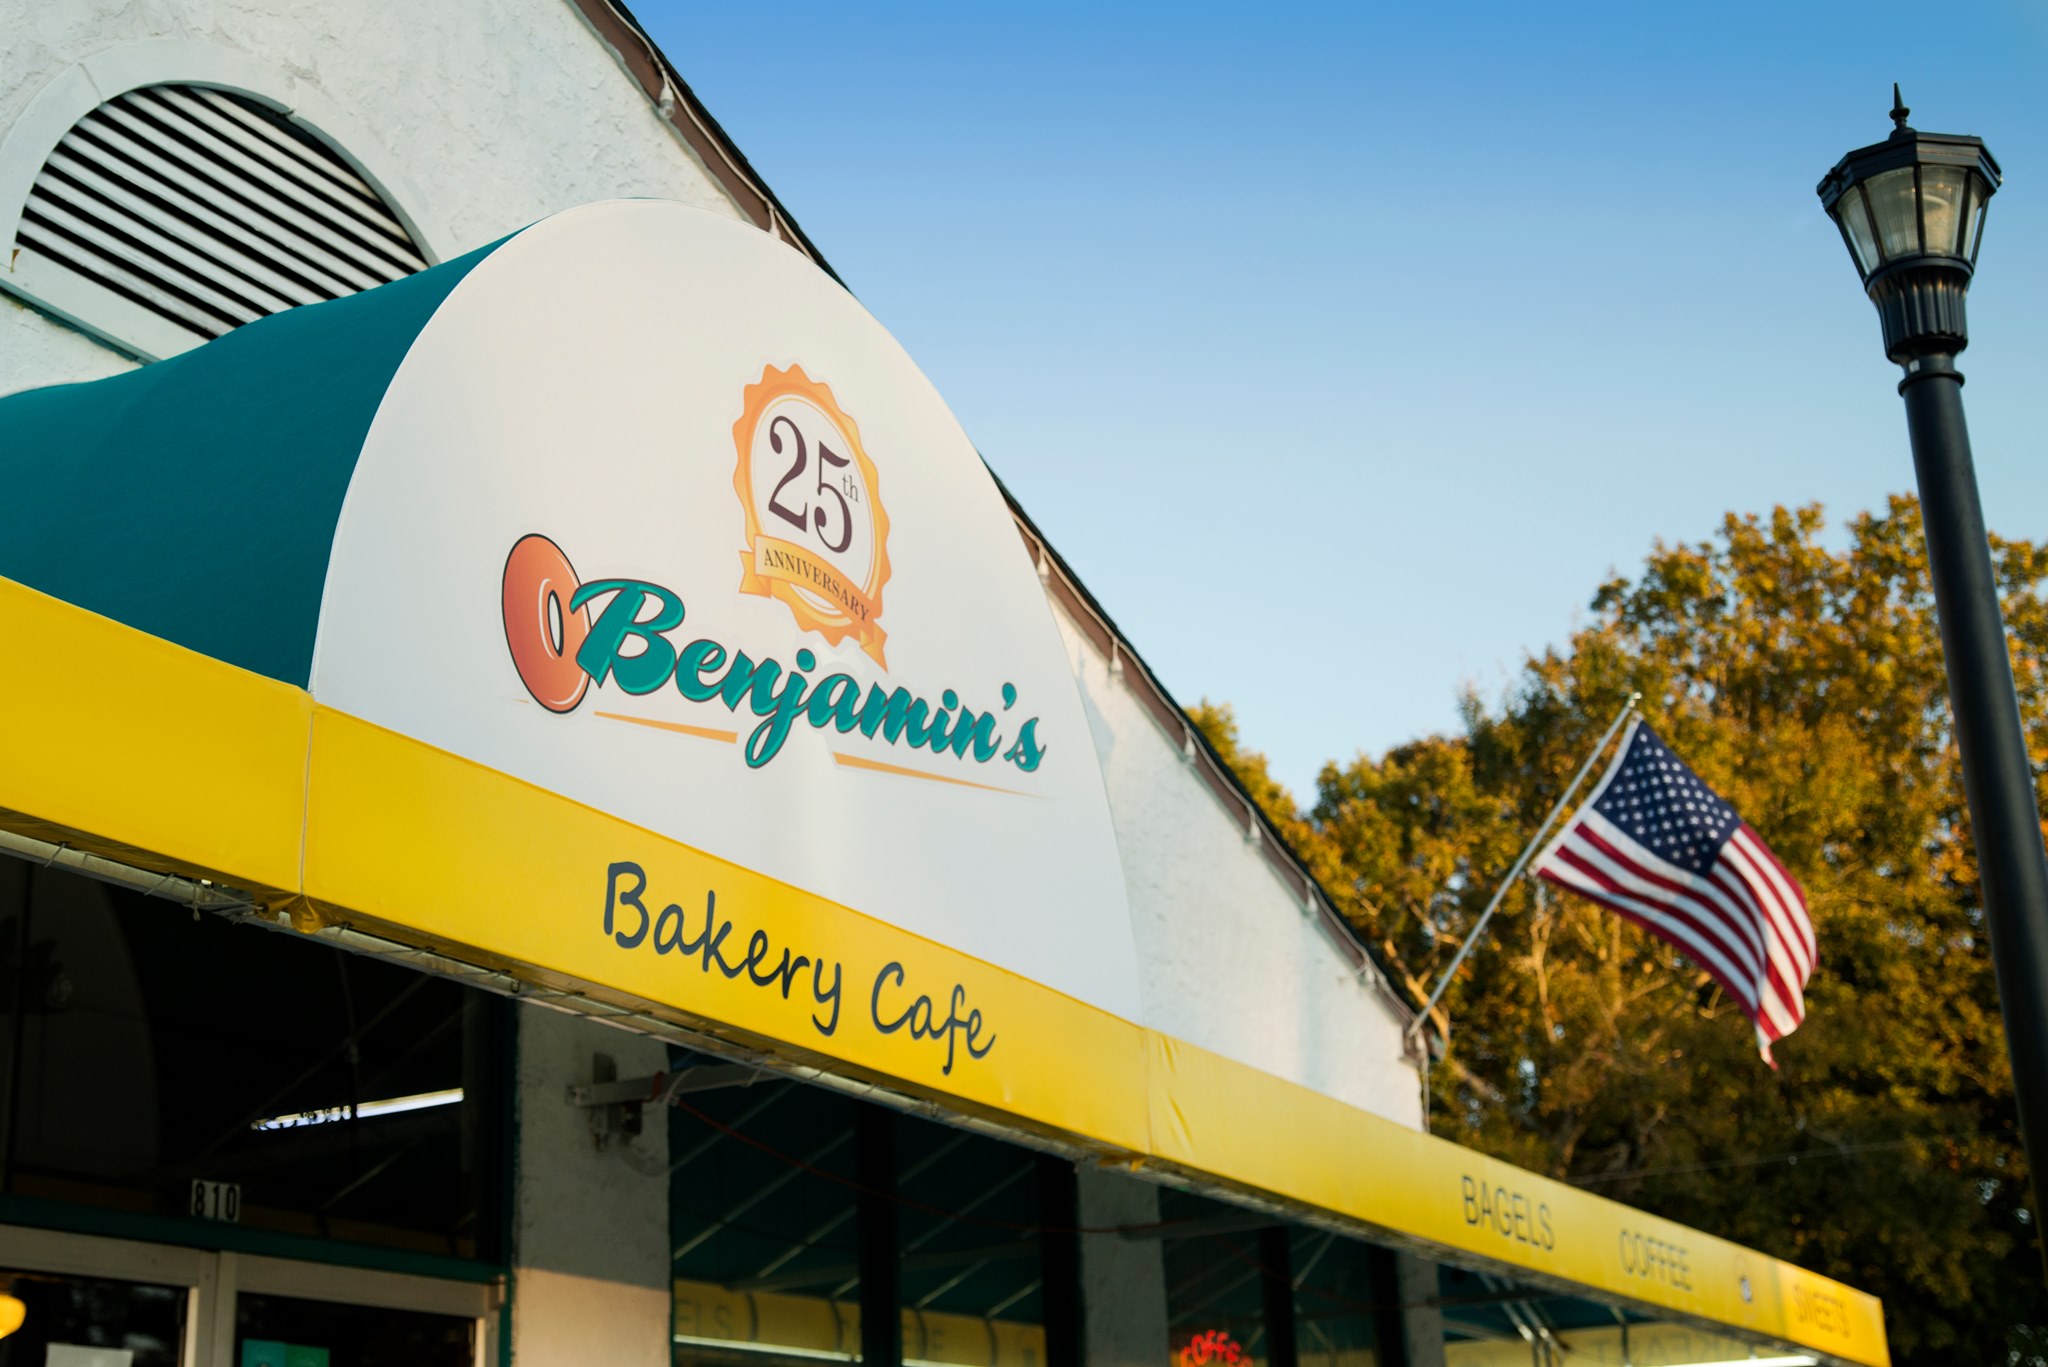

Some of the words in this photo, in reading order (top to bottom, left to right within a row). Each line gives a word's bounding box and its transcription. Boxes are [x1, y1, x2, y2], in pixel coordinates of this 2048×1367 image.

[764, 548, 869, 622] ANNIVERSARY
[570, 578, 1046, 771] Benjamin's
[603, 861, 841, 1036] Bakery
[871, 961, 996, 1076] Cafe
[195, 1182, 237, 1219] 810
[1461, 1174, 1555, 1251] BAGELS
[1619, 1229, 1692, 1292] COFFEE
